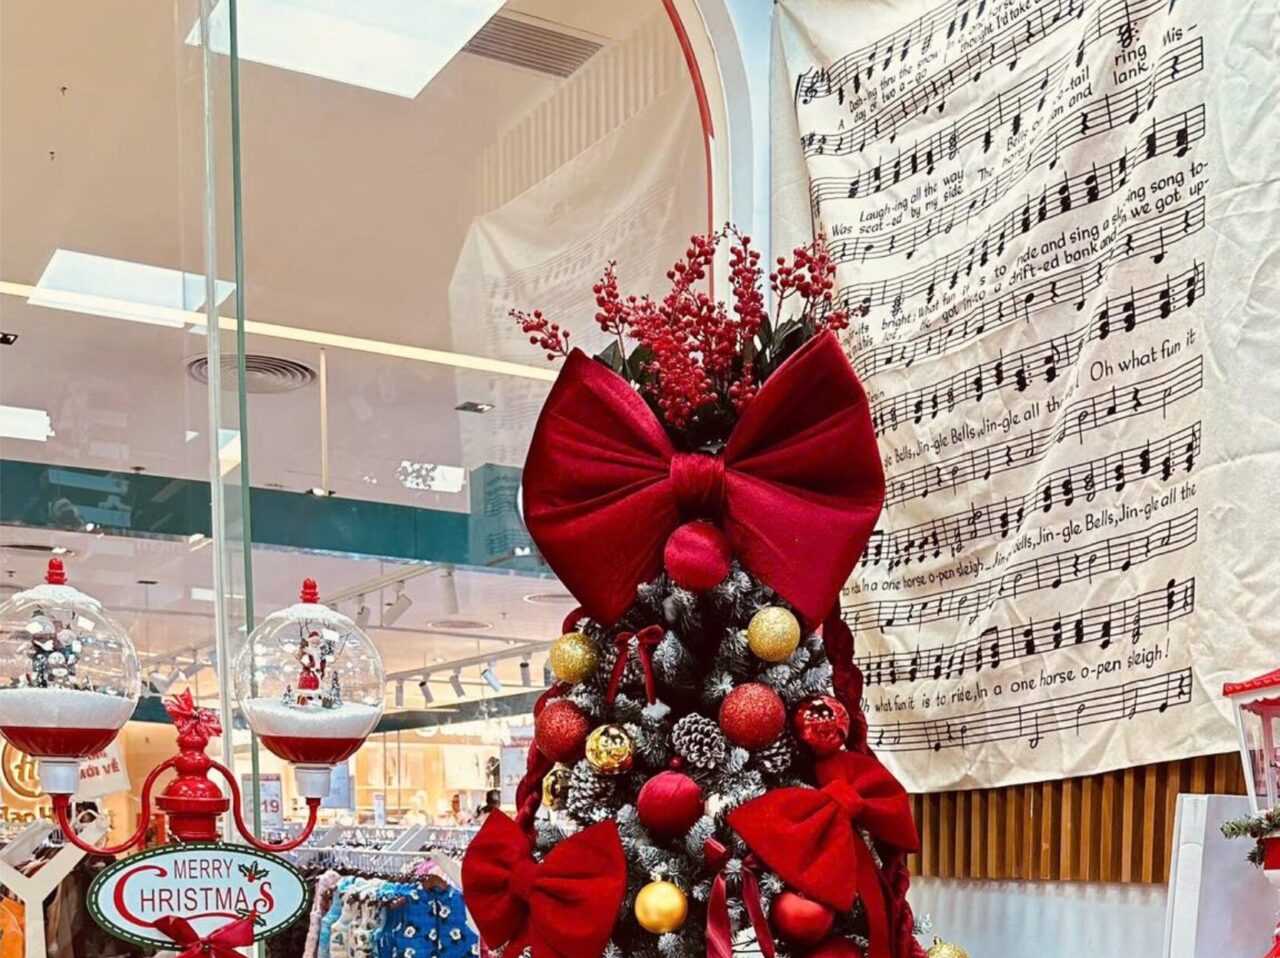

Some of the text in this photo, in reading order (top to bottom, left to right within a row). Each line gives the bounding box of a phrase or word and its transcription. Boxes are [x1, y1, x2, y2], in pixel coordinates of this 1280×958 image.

[942, 169, 964, 187] way
[1114, 44, 1148, 67] ring
[831, 223, 853, 237] Was
[1068, 83, 1093, 108] and
[942, 304, 960, 324] got
[1064, 241, 1099, 265] bank
[1130, 202, 1152, 218] we
[1155, 189, 1182, 214] got
[994, 264, 1007, 278] to
[1041, 232, 1067, 256] and
[1069, 227, 1100, 246] sing
[1150, 171, 1185, 193] song
[1090, 327, 1197, 382] Oh what fun it
[1023, 402, 1040, 421] all
[881, 579, 901, 592] one
[1160, 489, 1177, 508] all
[1180, 481, 1197, 501] the
[922, 693, 931, 708] is
[935, 692, 947, 707] to
[993, 685, 1002, 696] a
[1010, 678, 1037, 693] one
[1040, 669, 1076, 687] horse
[113, 864, 274, 928] CHRISTMAS
[173, 858, 234, 880] MERRY
